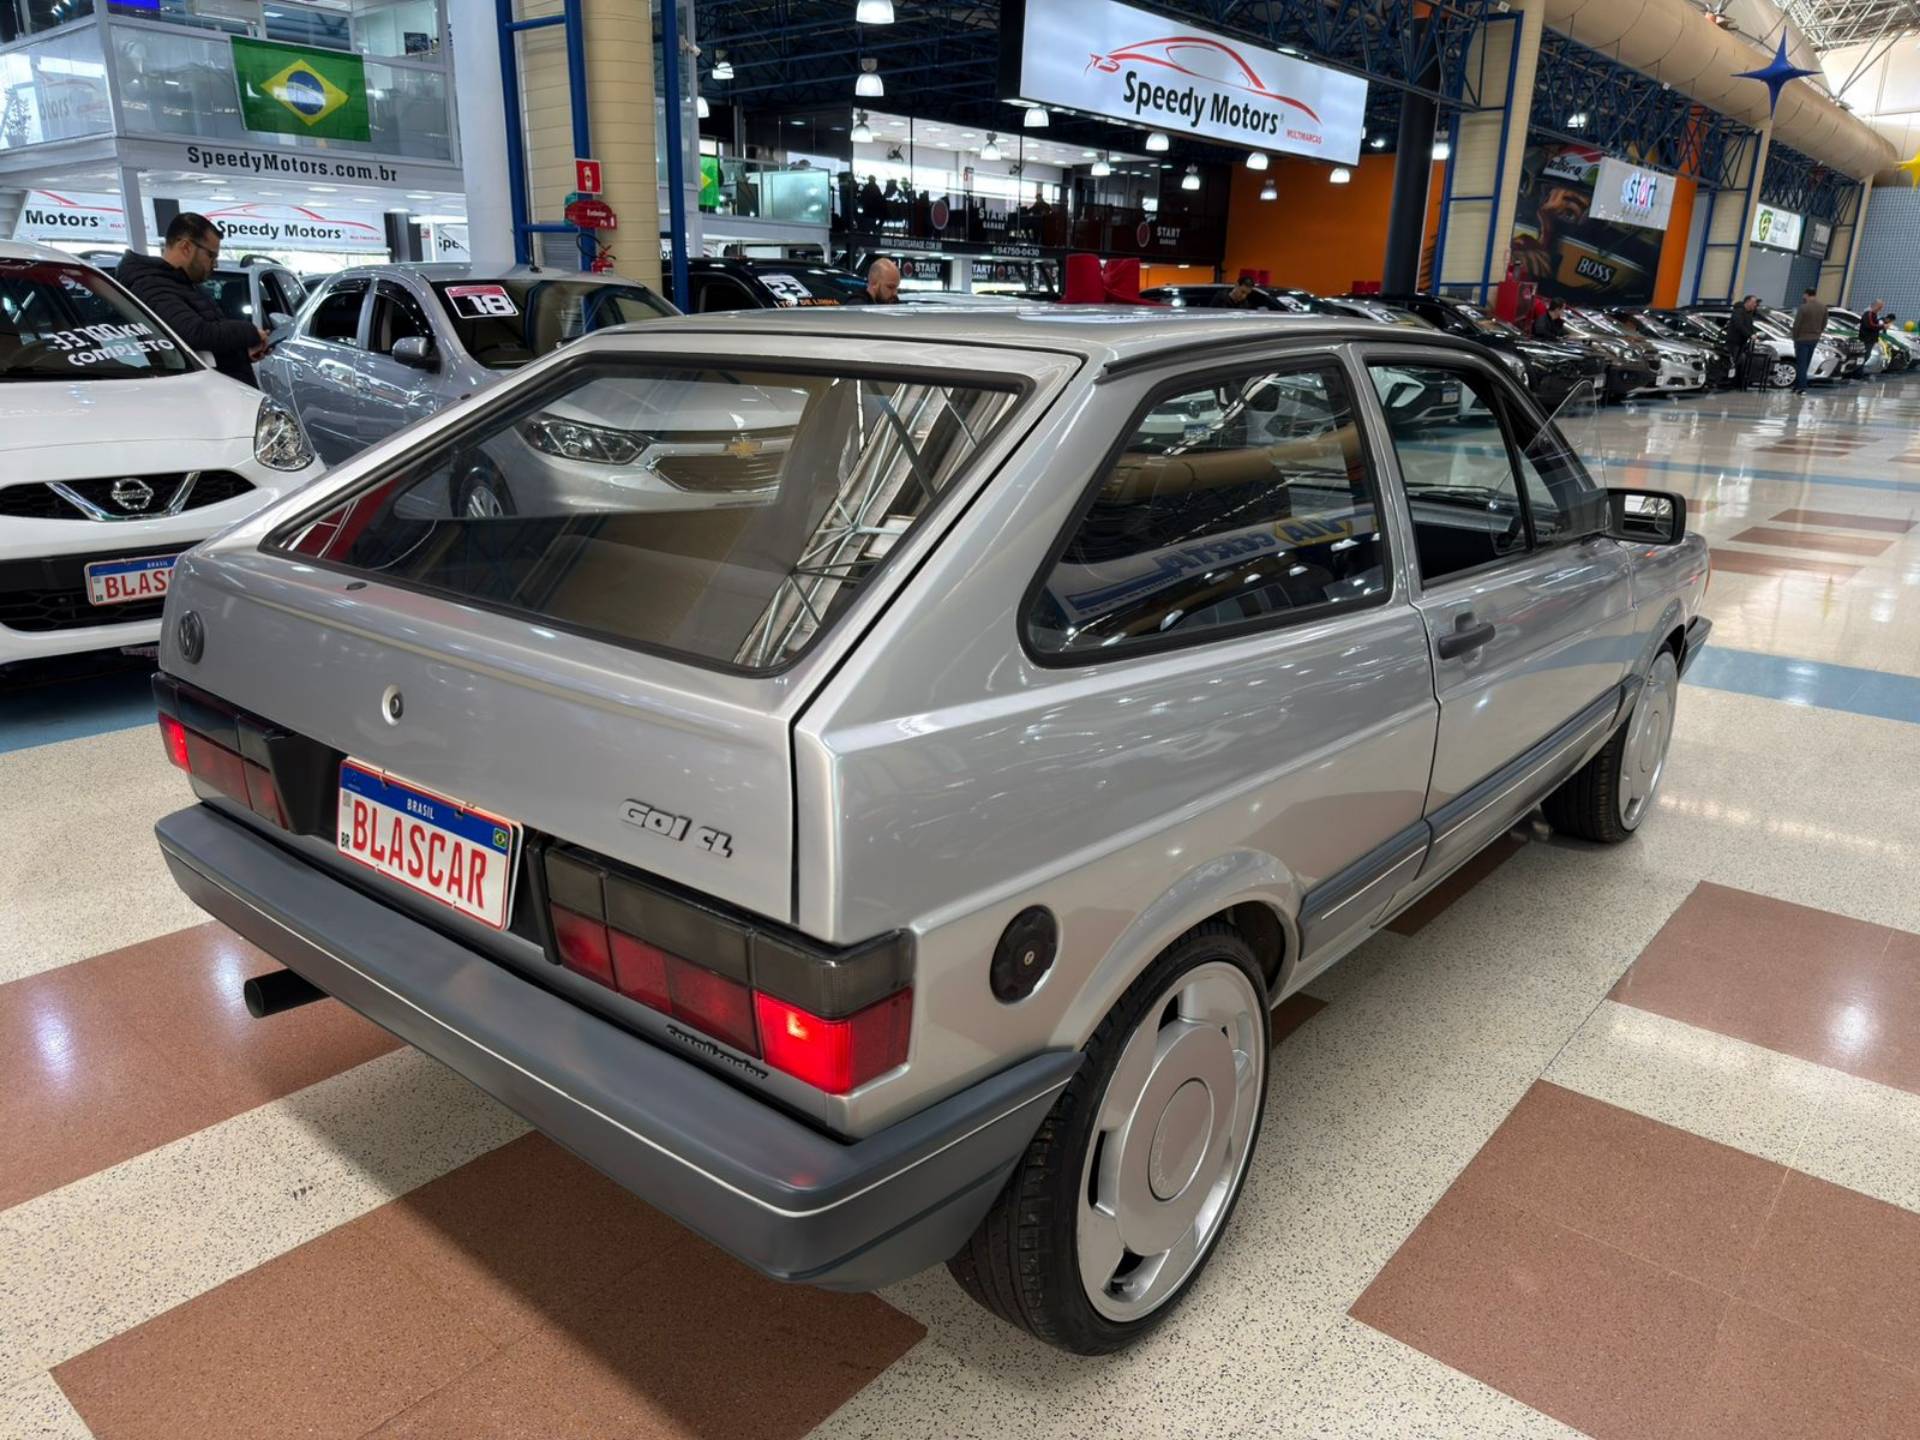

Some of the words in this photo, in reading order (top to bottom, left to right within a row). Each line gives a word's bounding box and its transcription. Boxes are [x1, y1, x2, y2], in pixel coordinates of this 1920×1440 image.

[1123, 71, 1206, 127] Speedy
[1210, 93, 1279, 135] Motors
[188, 146, 397, 181] SpeedyMotors.com.br
[25, 210, 99, 227] Motors
[978, 207, 1008, 222] START
[217, 221, 279, 240] Speedy
[284, 223, 342, 239] Motors
[1157, 226, 1181, 238] START
[915, 263, 941, 273] START
[1577, 257, 1613, 282] BOSS
[467, 295, 514, 314] 18
[67, 338, 175, 366] COMPLETO
[407, 798, 435, 820] BRASIL
[341, 832, 350, 849] BR
[352, 799, 487, 909] BLASCAR
